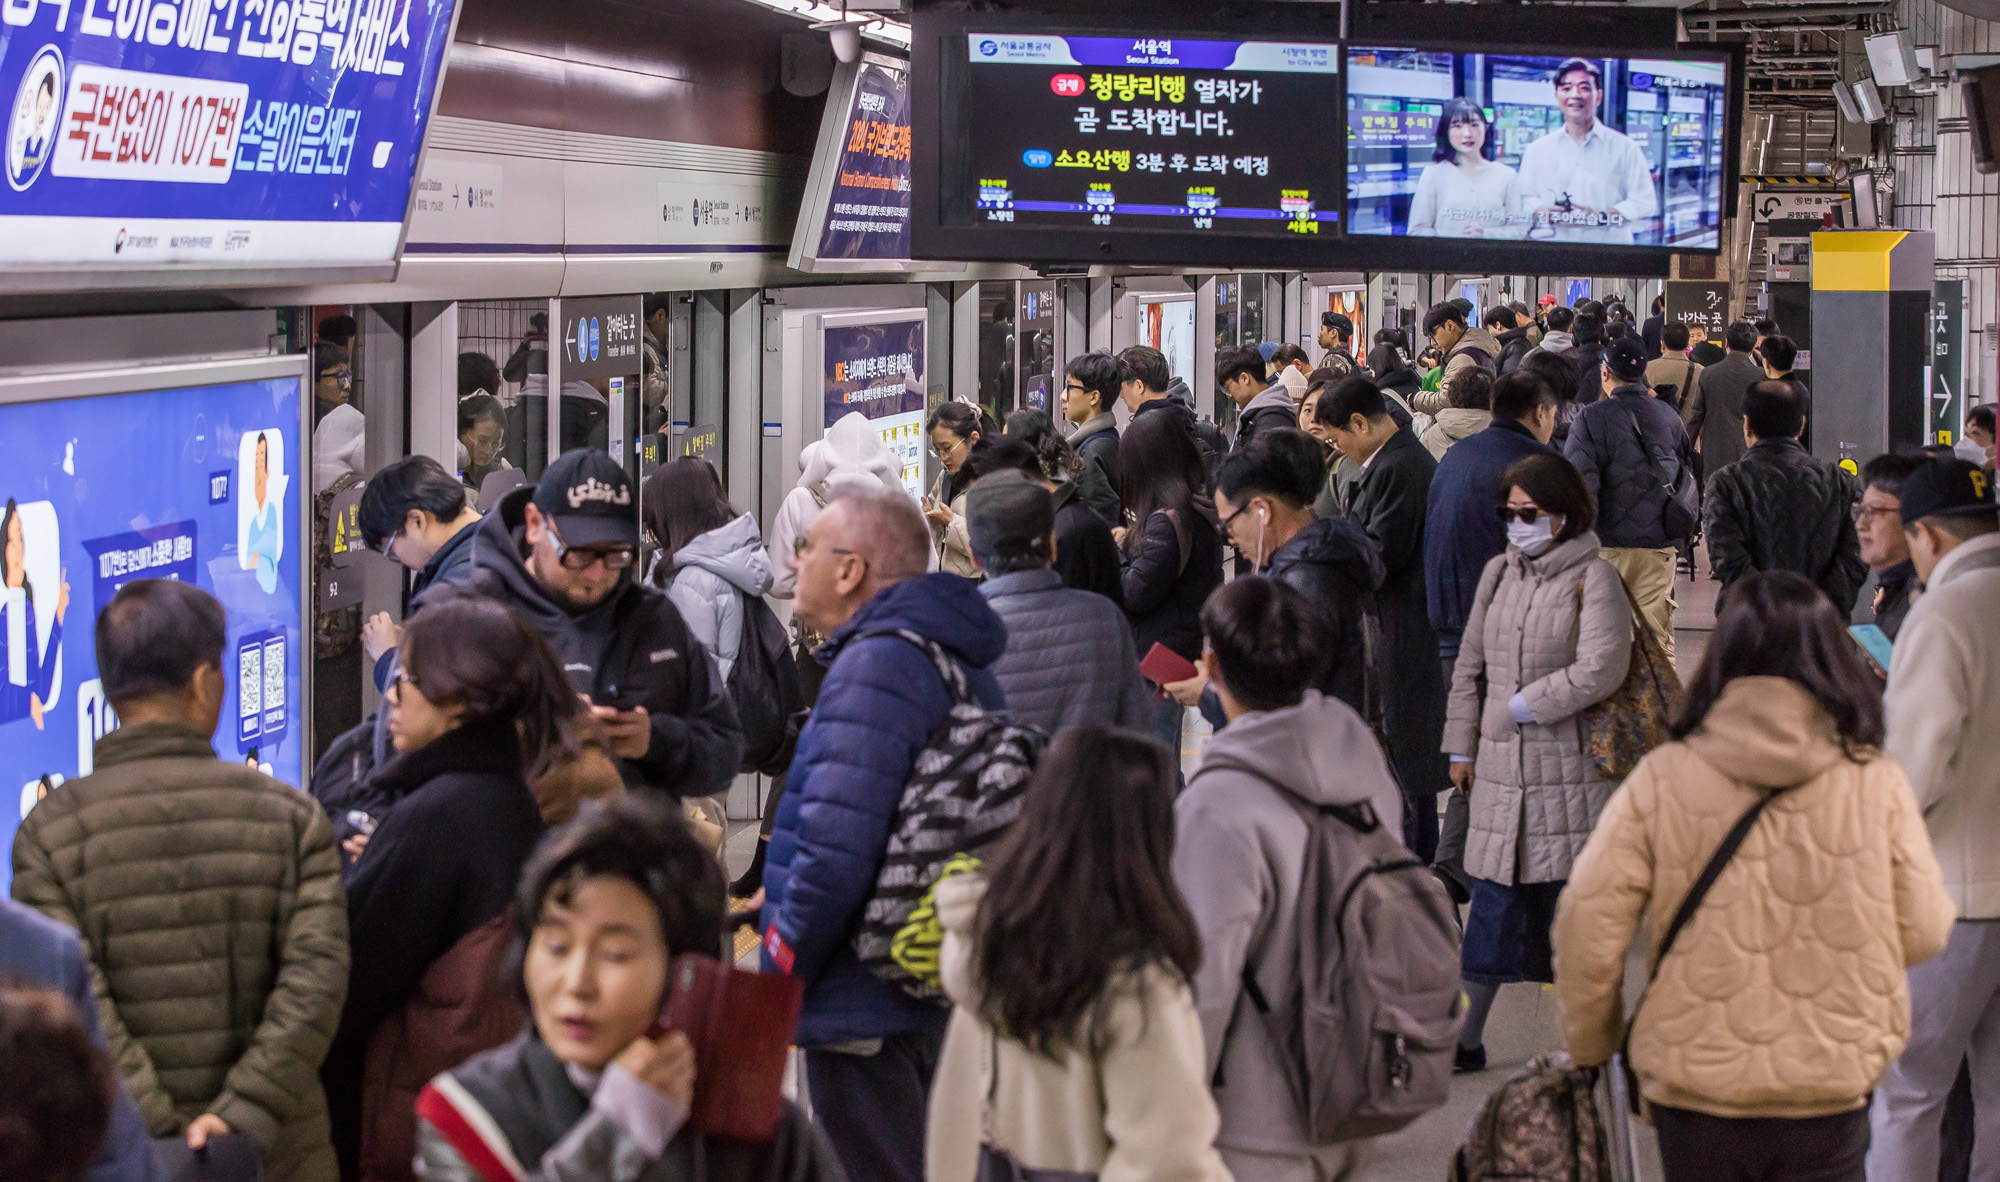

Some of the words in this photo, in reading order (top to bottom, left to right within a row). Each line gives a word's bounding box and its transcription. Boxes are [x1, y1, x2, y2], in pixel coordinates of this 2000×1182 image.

[1000, 41, 1052, 51] 서울교통공사
[1133, 38, 1172, 55] 서울역
[1126, 55, 1149, 65] Seoul
[1151, 56, 1179, 66] Station
[1056, 79, 1079, 92] 급행
[1089, 73, 1186, 103] 청량리행
[1193, 78, 1262, 104] 열차가
[69, 82, 174, 166] 국번없이
[172, 95, 240, 168] 107번
[235, 98, 362, 176] 손말이음센터
[1074, 107, 1100, 132] 곧
[1106, 108, 1234, 136] 도착합니다.
[848, 119, 870, 153] 2024
[1054, 149, 1131, 172] 소요산행
[1136, 153, 1165, 171] 3분
[1169, 154, 1189, 173] 후
[1193, 156, 1229, 175] 도착
[1233, 156, 1269, 176] 예정
[700, 199, 713, 225] 서울역
[1287, 221, 1319, 234] 서울역
[606, 313, 629, 342] 갈아타는
[629, 313, 636, 340] 곳
[1677, 311, 1709, 325] 나가는
[1711, 311, 1723, 325] 곳
[580, 325, 587, 355] 4
[211, 475, 228, 500] 107?
[1969, 470, 1987, 498] P
[151, 538, 174, 568] 소중한
